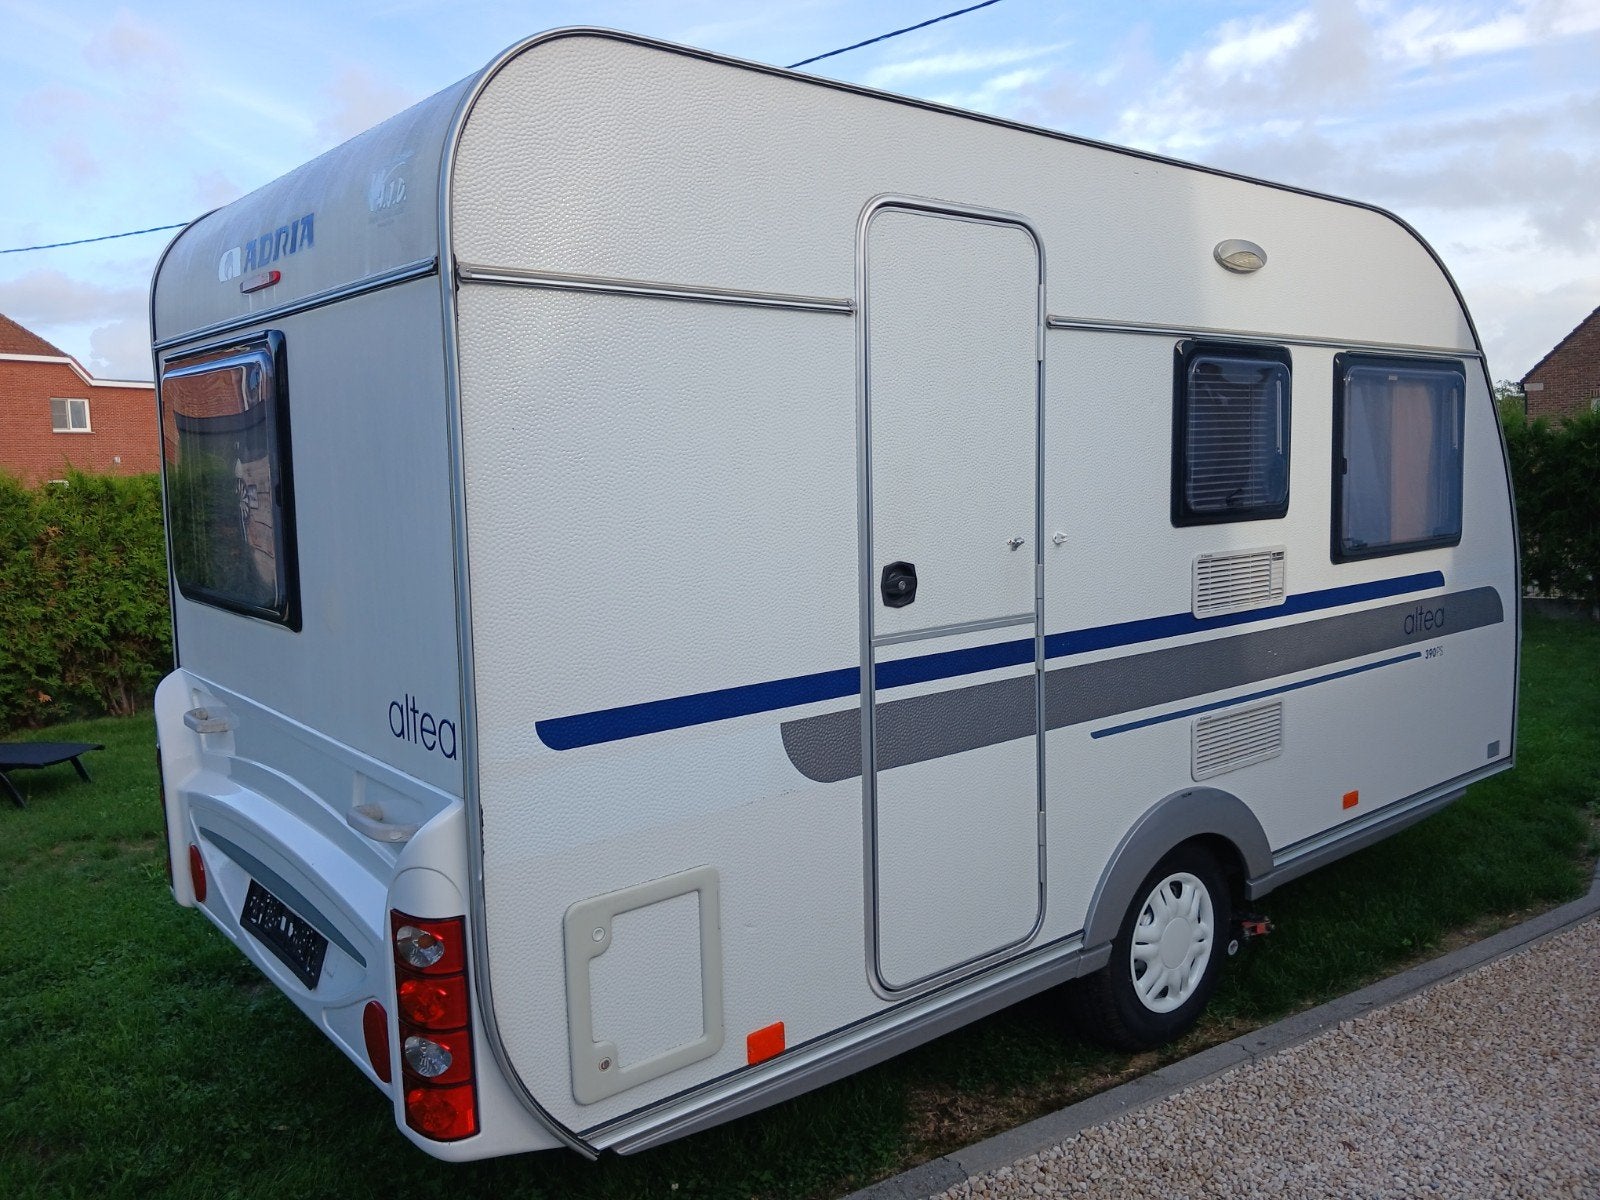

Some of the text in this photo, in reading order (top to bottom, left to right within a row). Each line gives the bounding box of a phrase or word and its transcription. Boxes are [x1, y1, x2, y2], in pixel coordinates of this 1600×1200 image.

[243, 212, 315, 274] ADRIA
[1403, 605, 1445, 635] altea
[388, 693, 457, 761] altea
